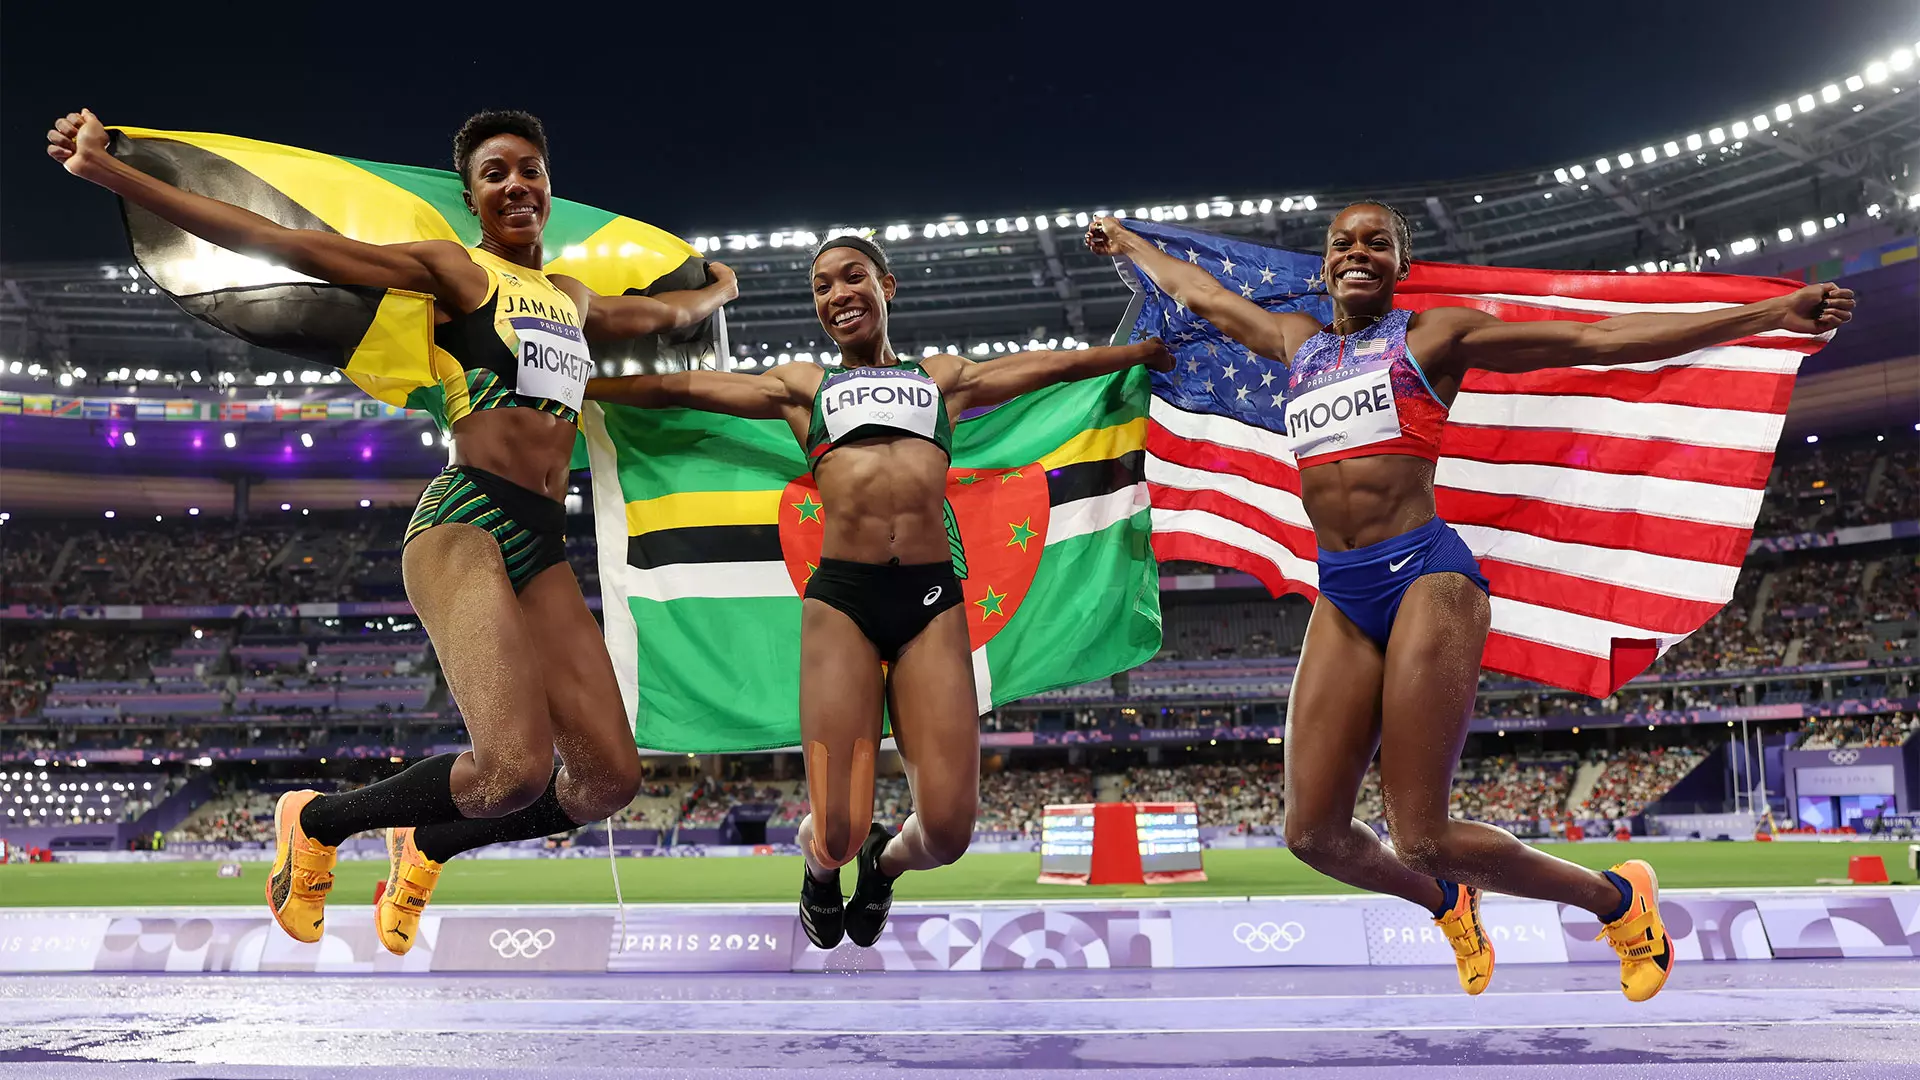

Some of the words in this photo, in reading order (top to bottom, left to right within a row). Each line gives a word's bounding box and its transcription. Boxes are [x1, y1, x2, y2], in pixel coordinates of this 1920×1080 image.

[505, 296, 580, 328] JAMAIC
[540, 321, 563, 334] PARIS
[564, 328, 581, 340] 202
[523, 341, 593, 386] RICKETT
[848, 369, 877, 378] PARIS
[1307, 374, 1333, 389] PARIS
[1335, 366, 1361, 383] 2024
[826, 386, 933, 416] LAFOND
[1289, 383, 1391, 439] MOORE
[625, 934, 700, 951] PARIS
[708, 934, 777, 950] 2024
[1491, 924, 1546, 941] 024
